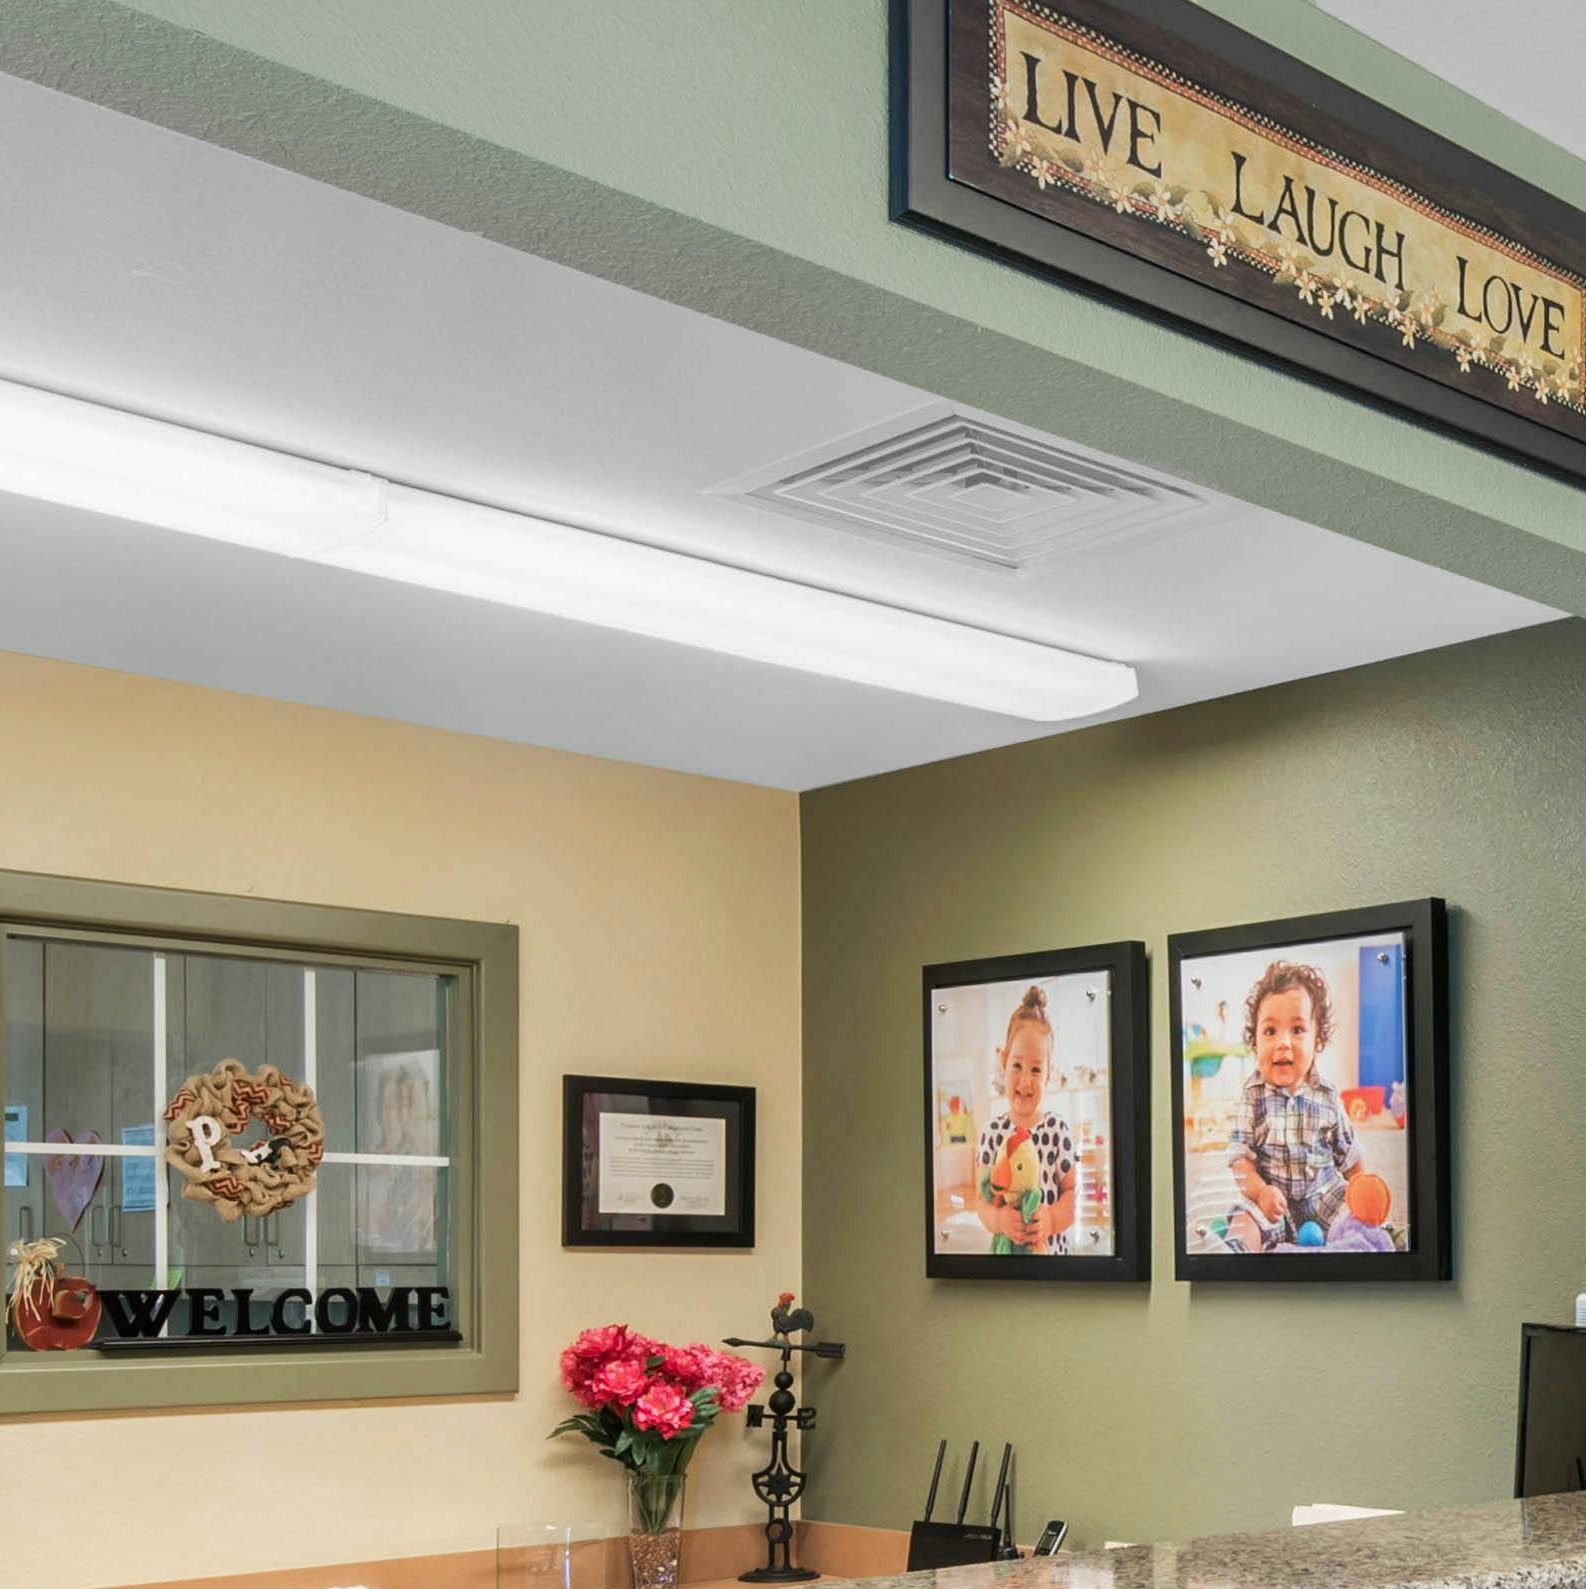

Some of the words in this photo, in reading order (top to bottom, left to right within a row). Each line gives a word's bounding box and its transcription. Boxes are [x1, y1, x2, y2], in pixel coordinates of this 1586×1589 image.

[1020, 51, 1163, 179] LIVE
[1229, 151, 1405, 293] LAUGH
[1454, 255, 1566, 360] LOVE
[98, 1287, 451, 1338] WELCOME
